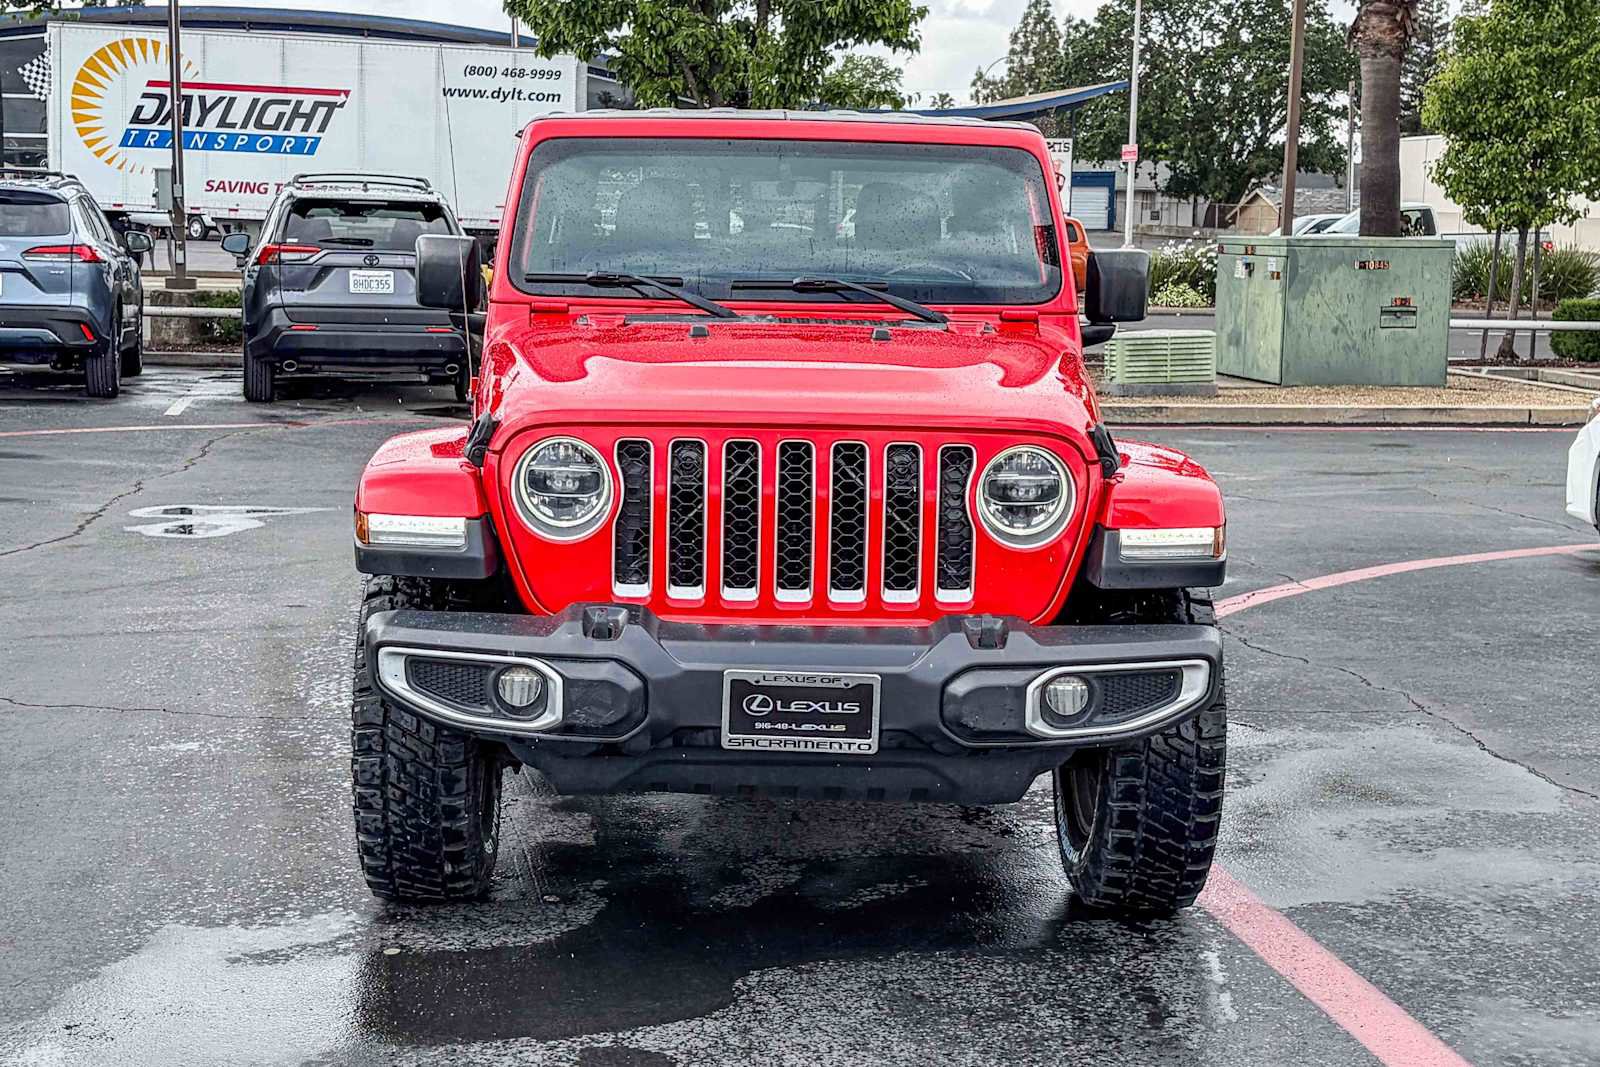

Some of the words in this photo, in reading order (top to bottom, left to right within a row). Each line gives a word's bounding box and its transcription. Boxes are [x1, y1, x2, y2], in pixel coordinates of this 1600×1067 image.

[464, 64, 497, 79] (800)
[501, 67, 561, 80] 468-9999
[442, 87, 561, 103] www.dylt.com
[129, 92, 348, 134] DAYLIGHT
[204, 179, 269, 195] SAVING
[762, 674, 817, 684] LEXUS
[820, 677, 842, 685] OF
[776, 699, 861, 714] LEXUS
[727, 737, 872, 751] SACRAMENTO
